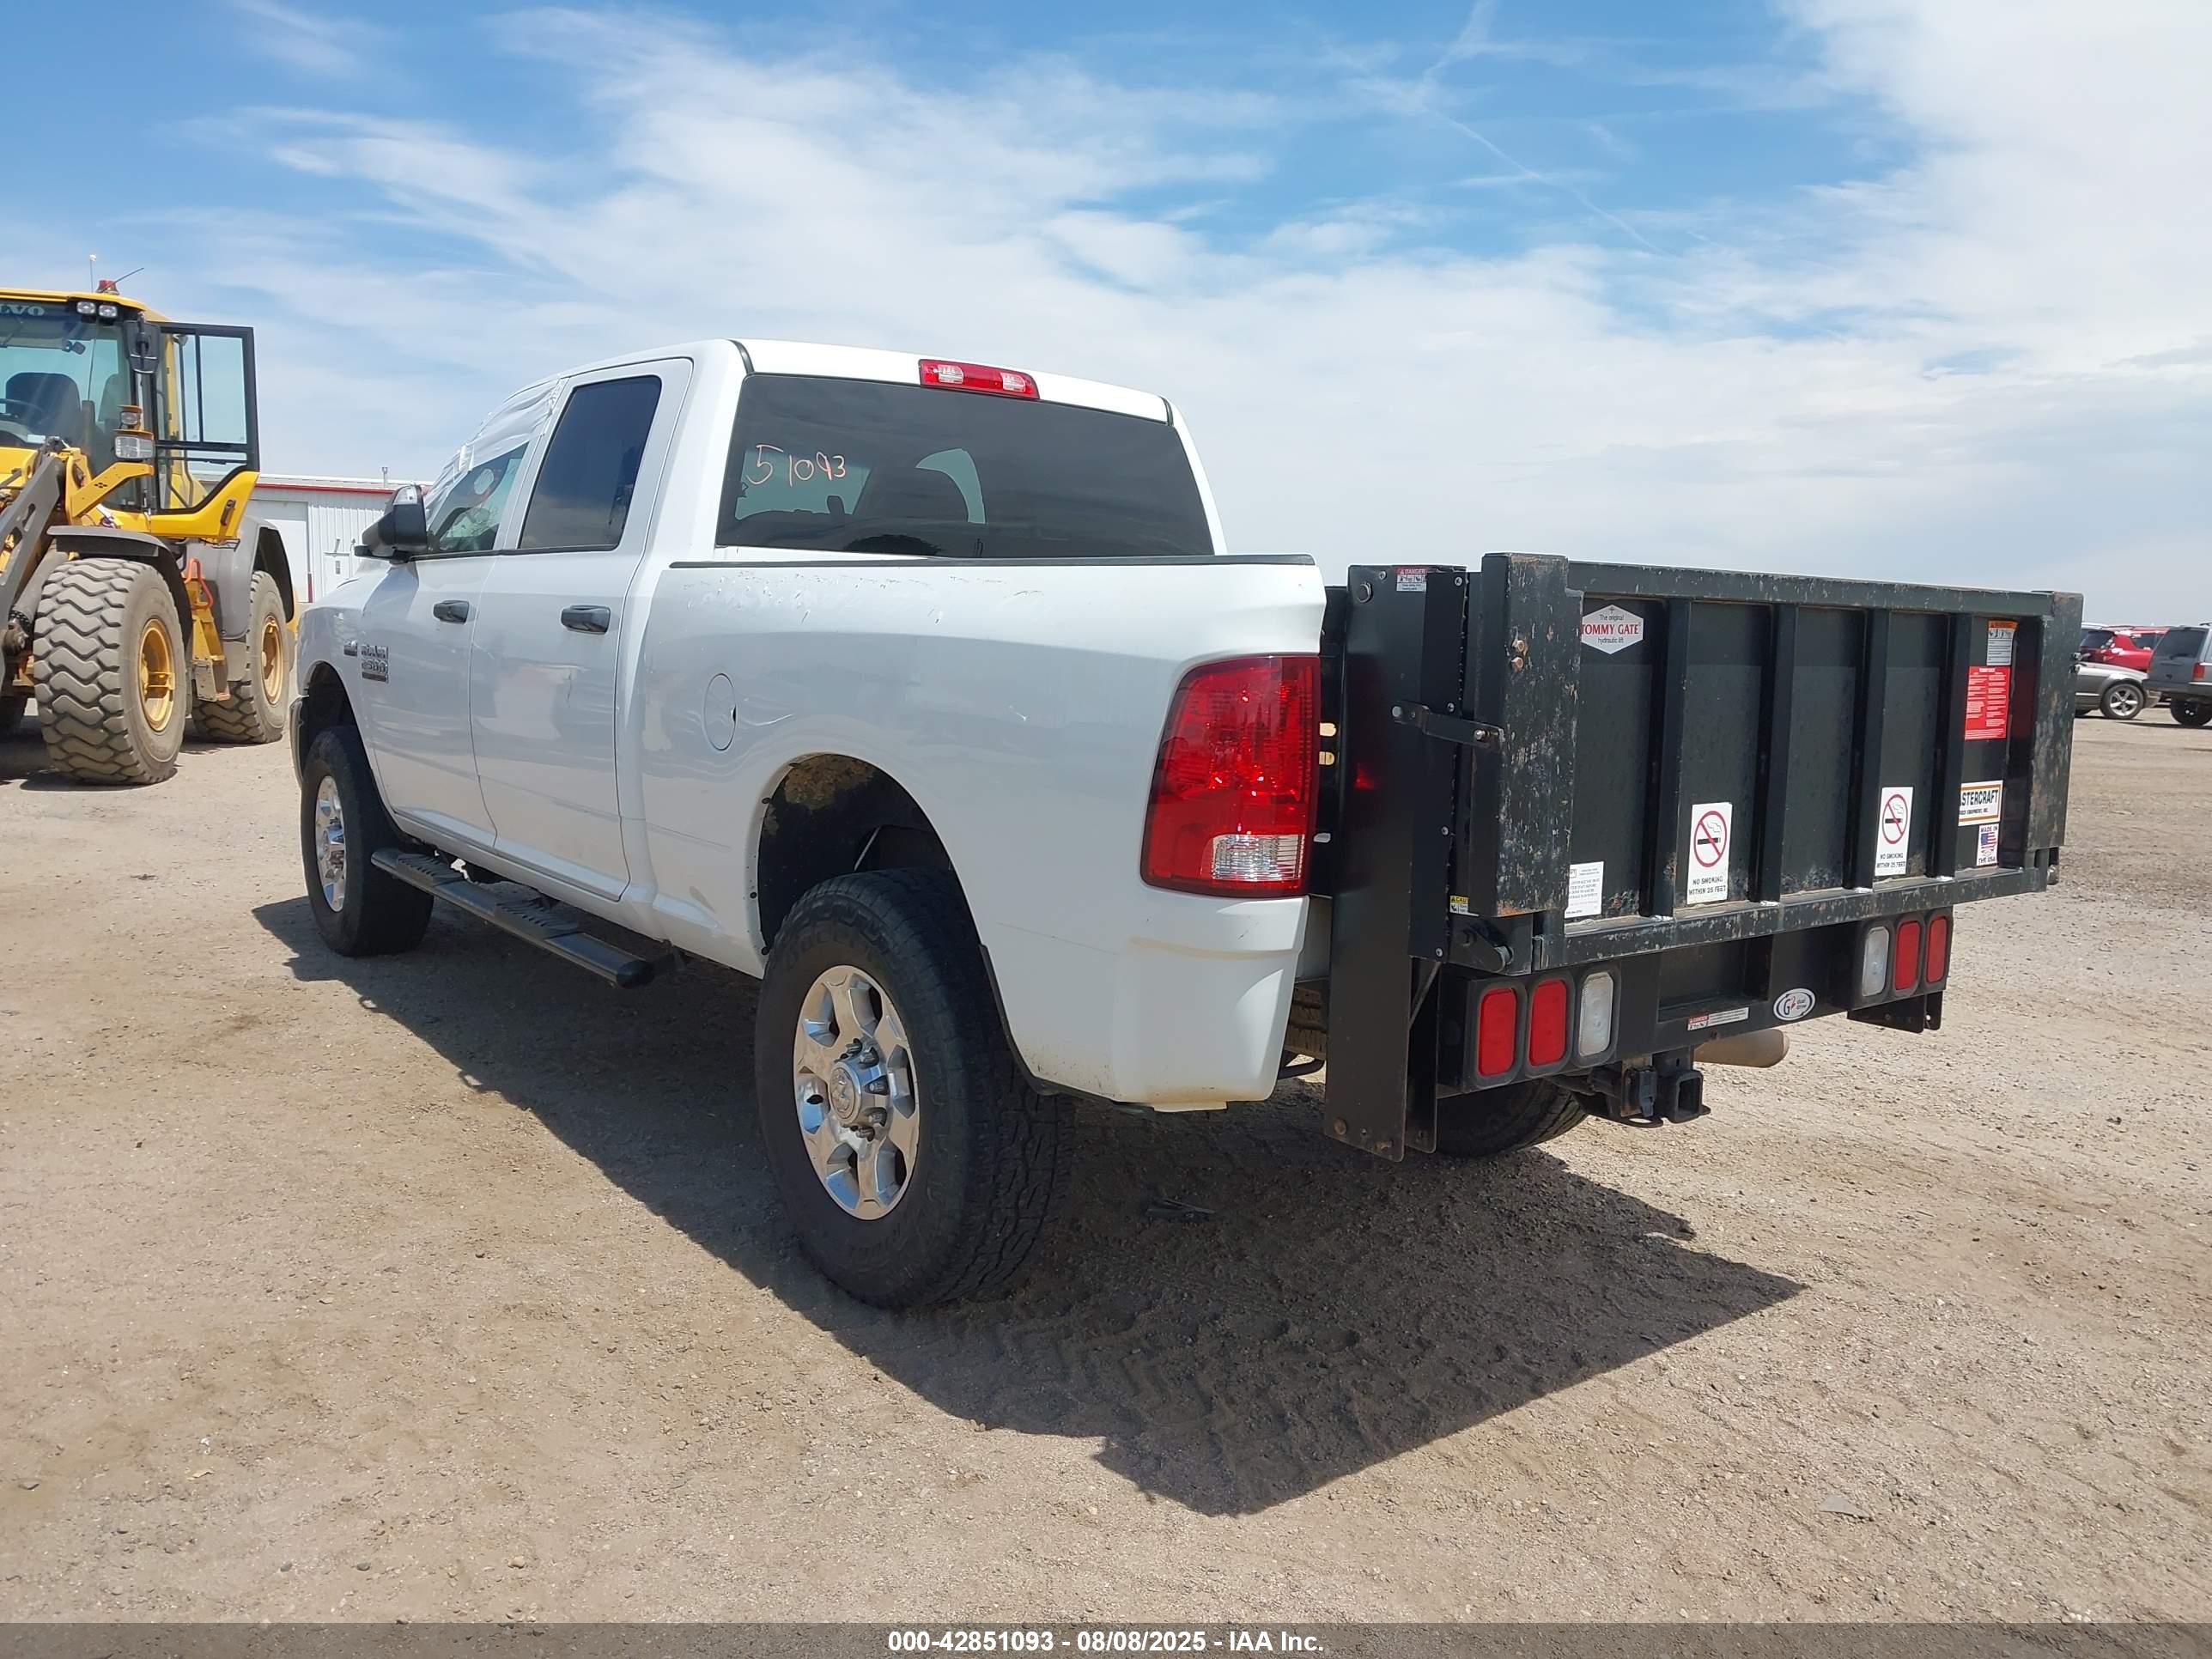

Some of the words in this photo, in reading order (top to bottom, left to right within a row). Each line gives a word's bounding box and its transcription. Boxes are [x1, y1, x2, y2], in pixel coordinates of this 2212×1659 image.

[745, 443, 847, 487] 51093
[1581, 623, 1614, 635] TOMMY
[1618, 623, 1639, 635] GATE
[1961, 789, 1999, 806] STERCRAFT
[1701, 875, 1723, 884] SMOKING
[1689, 887, 1706, 896] WITHIN
[1714, 884, 1726, 893] FEET
